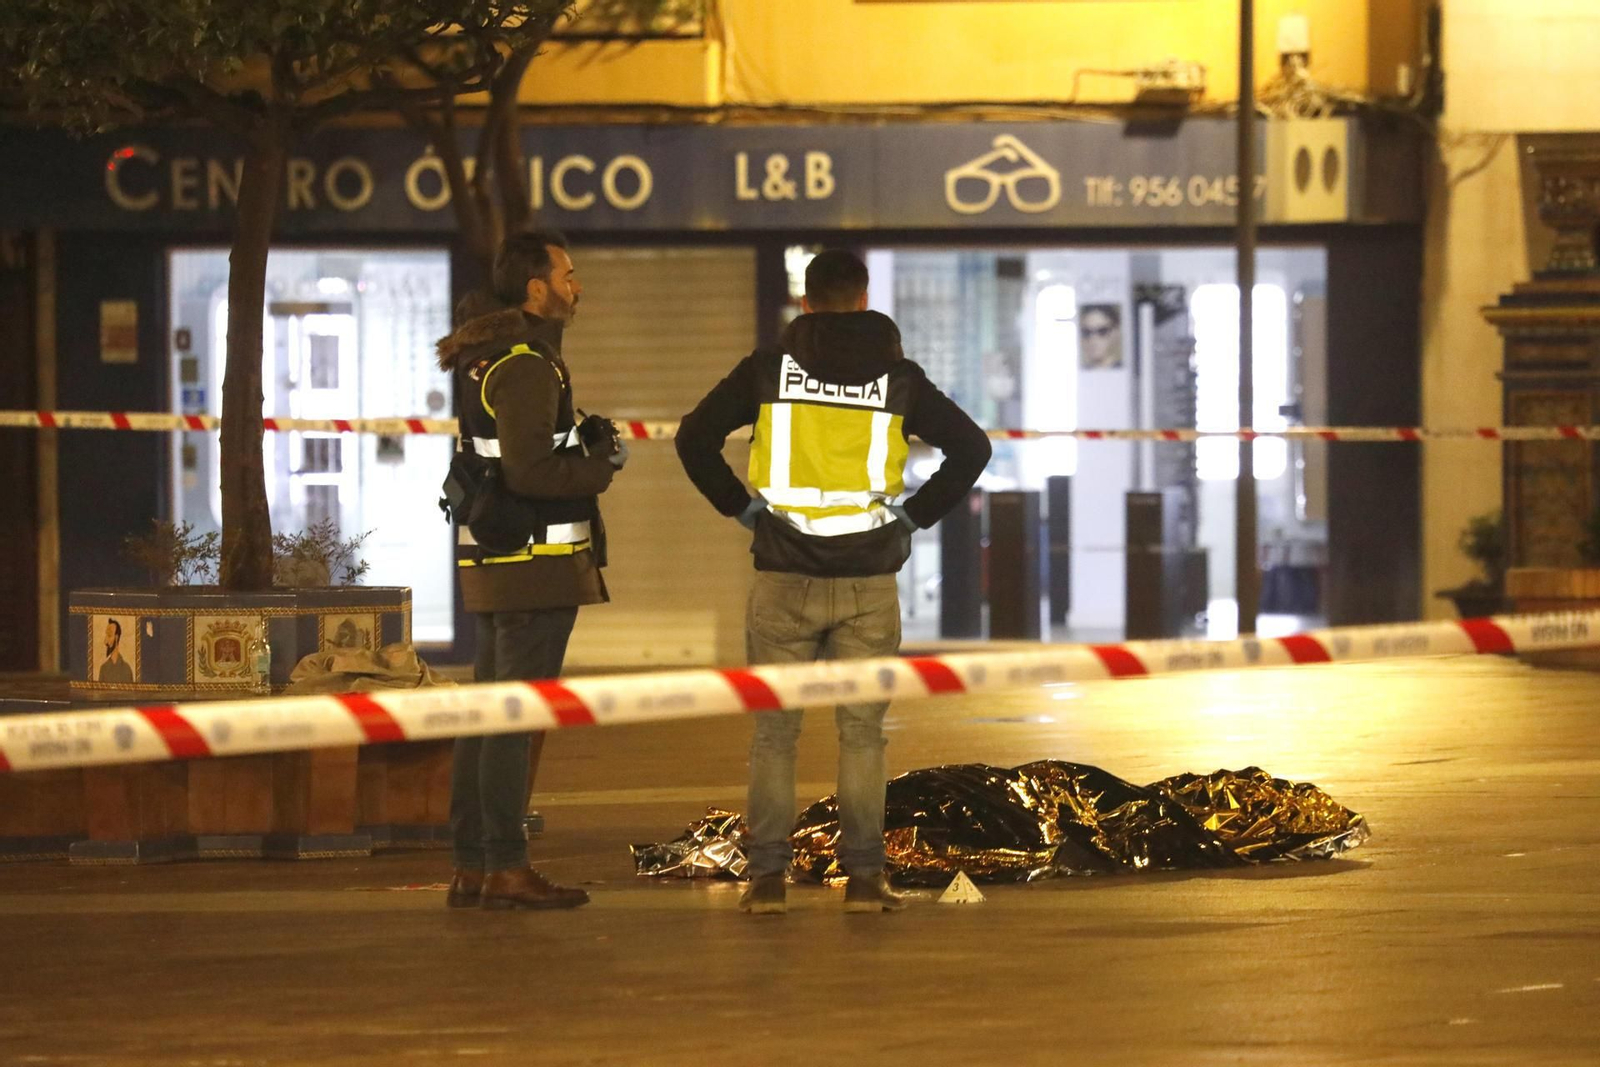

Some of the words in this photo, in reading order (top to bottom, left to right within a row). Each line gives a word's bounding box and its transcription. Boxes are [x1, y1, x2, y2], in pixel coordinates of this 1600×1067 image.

[105, 144, 375, 212] CENRO
[404, 144, 654, 212] ÓICO
[1128, 175, 1184, 207] 956
